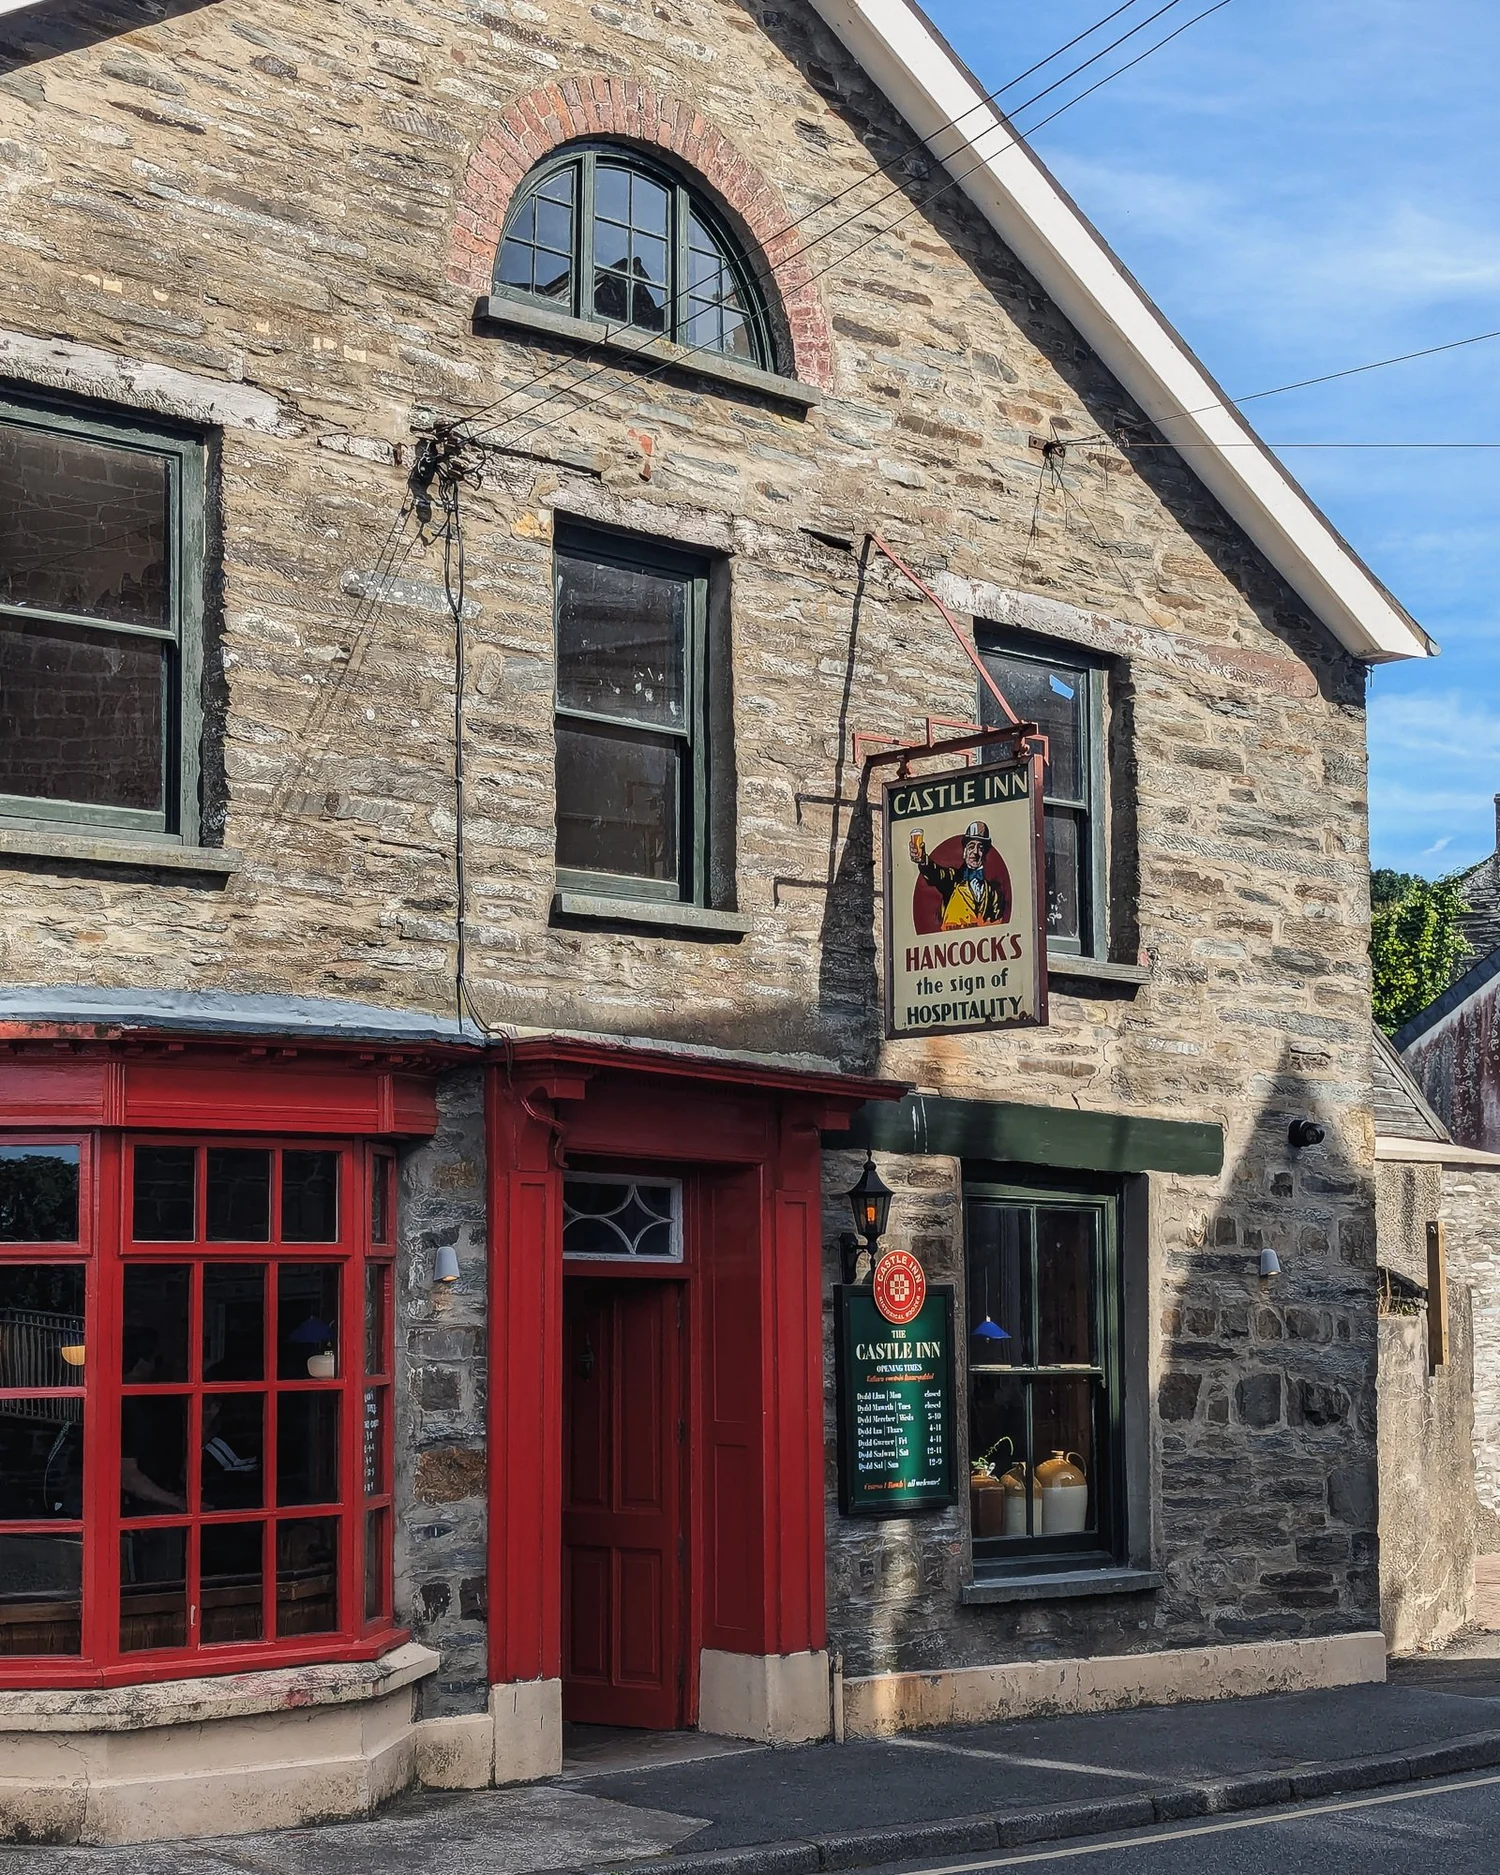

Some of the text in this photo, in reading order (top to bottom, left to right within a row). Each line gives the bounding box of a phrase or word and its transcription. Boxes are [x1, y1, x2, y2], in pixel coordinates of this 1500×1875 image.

[894, 771, 1028, 815] CASTLE INN
[906, 932, 1022, 972] HANCOCK'S
[916, 968, 1009, 996] the sign of
[907, 996, 1023, 1026] HOSPITALITY
[877, 1254, 922, 1283] CASTLE INN
[891, 1330, 906, 1339] THE
[856, 1341, 941, 1360] CASTLE INN
[876, 1363, 923, 1372] OPENING TIMES
[924, 1389, 941, 1398] closed
[897, 1402, 911, 1410] Tues
[924, 1401, 941, 1409] closed
[899, 1448, 909, 1457] Sat
[927, 1446, 942, 1455] 12-11
